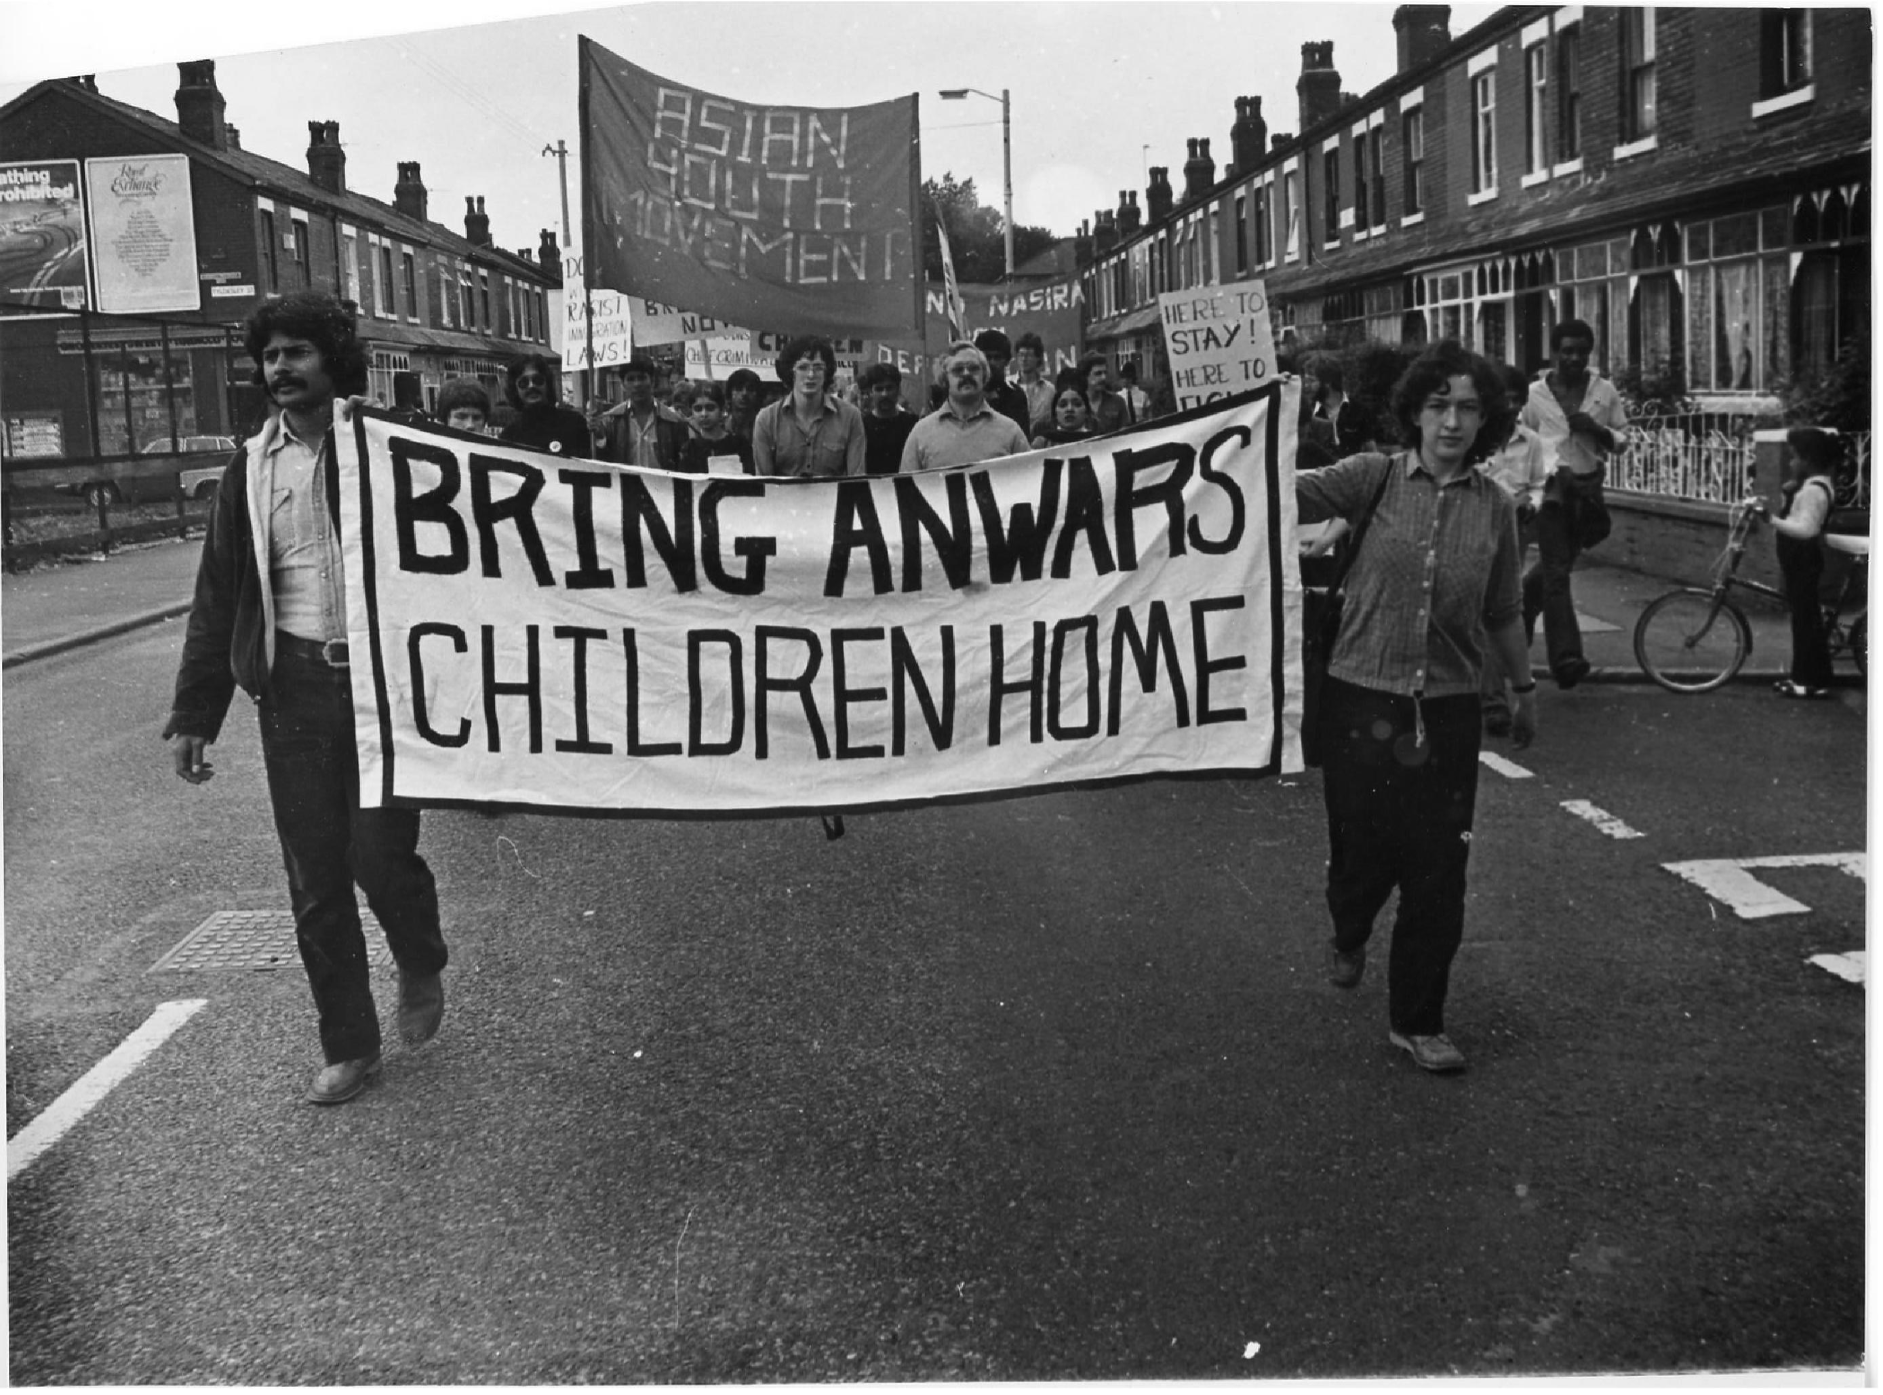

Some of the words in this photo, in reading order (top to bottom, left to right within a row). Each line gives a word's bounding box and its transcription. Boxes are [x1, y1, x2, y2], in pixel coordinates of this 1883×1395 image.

[654, 87, 848, 168] ASIAN
[648, 142, 851, 229] YOUTH
[603, 184, 900, 284] MOVEMENT
[989, 280, 1085, 317] NASIRA
[1165, 298, 1226, 324] HERE
[1236, 292, 1265, 314] TO
[566, 339, 628, 366] LAWS!
[1176, 363, 1230, 388] HERE
[1239, 357, 1266, 381] TO
[388, 436, 777, 596] BRING
[823, 425, 1252, 598] ANWARS
[408, 622, 956, 760] CHILDREN
[987, 595, 1248, 747] HOME
